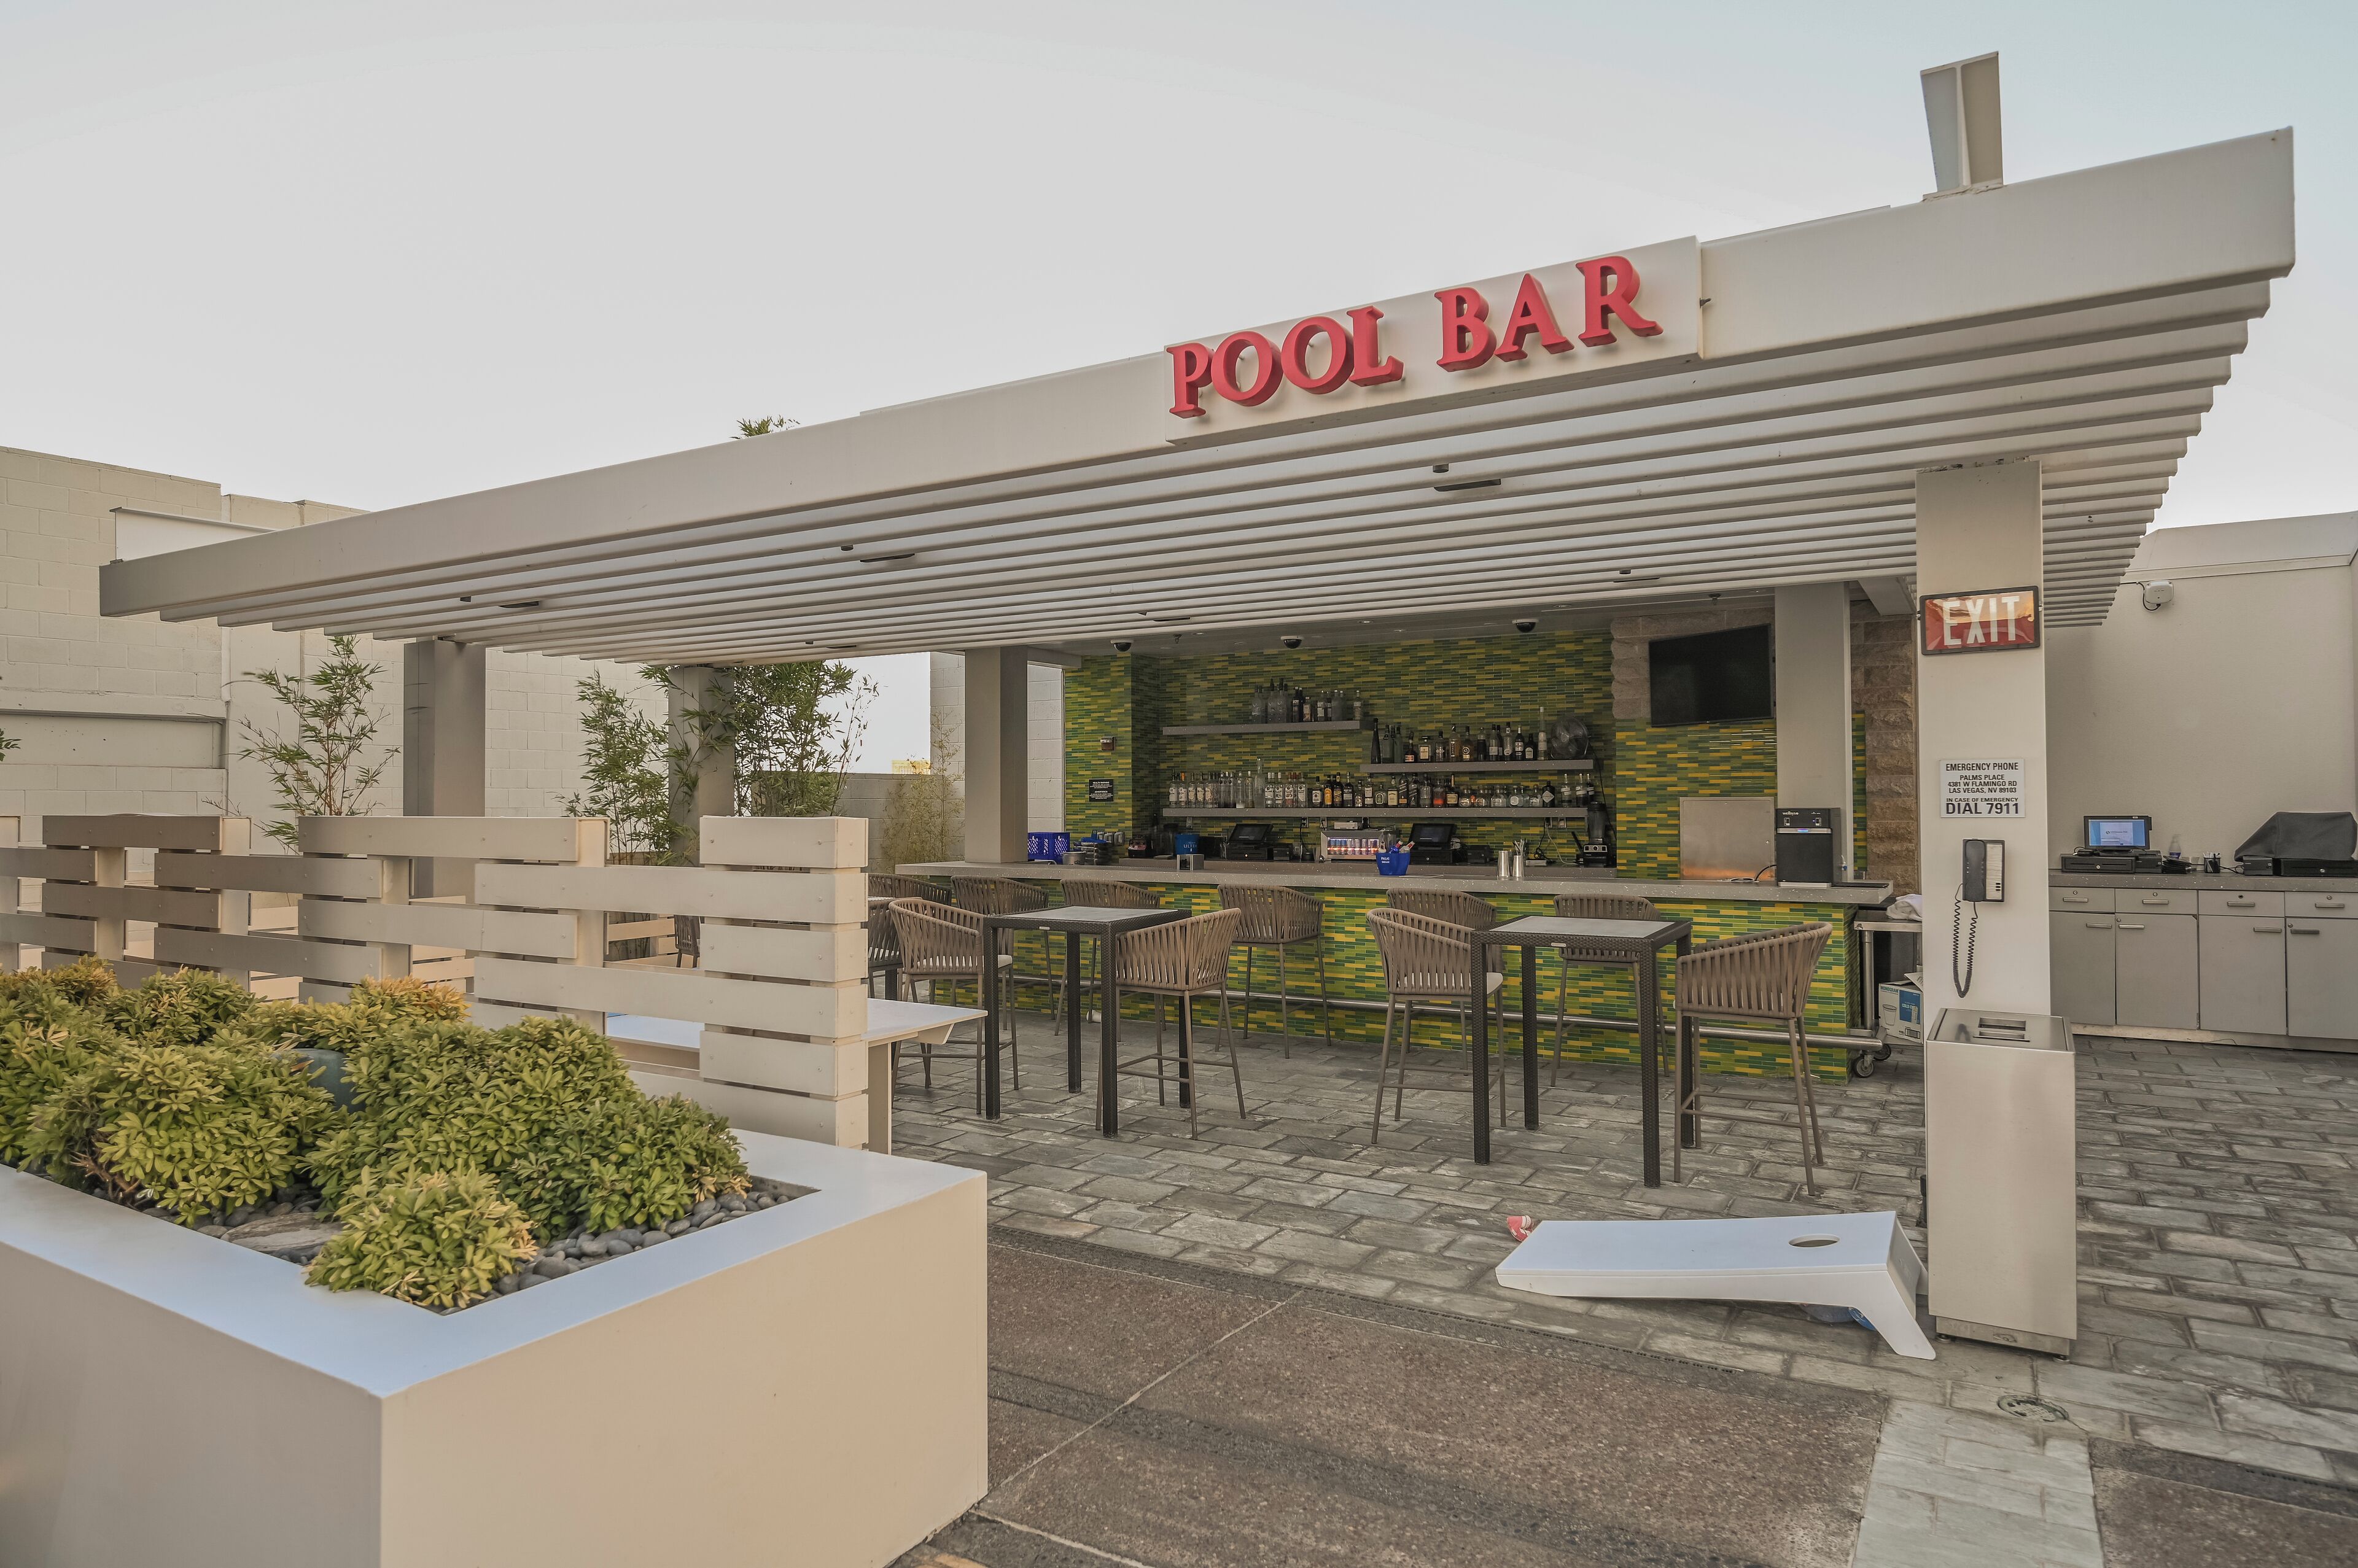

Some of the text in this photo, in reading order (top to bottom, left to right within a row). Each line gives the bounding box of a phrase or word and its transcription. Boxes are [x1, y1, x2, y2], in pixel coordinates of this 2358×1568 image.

[1166, 255, 1664, 419] POOL BAR
[1942, 596, 2020, 646] EXIT
[1946, 762, 2019, 771] EMERGENCY PHONE
[1946, 802, 2018, 814] DIAL 7911
